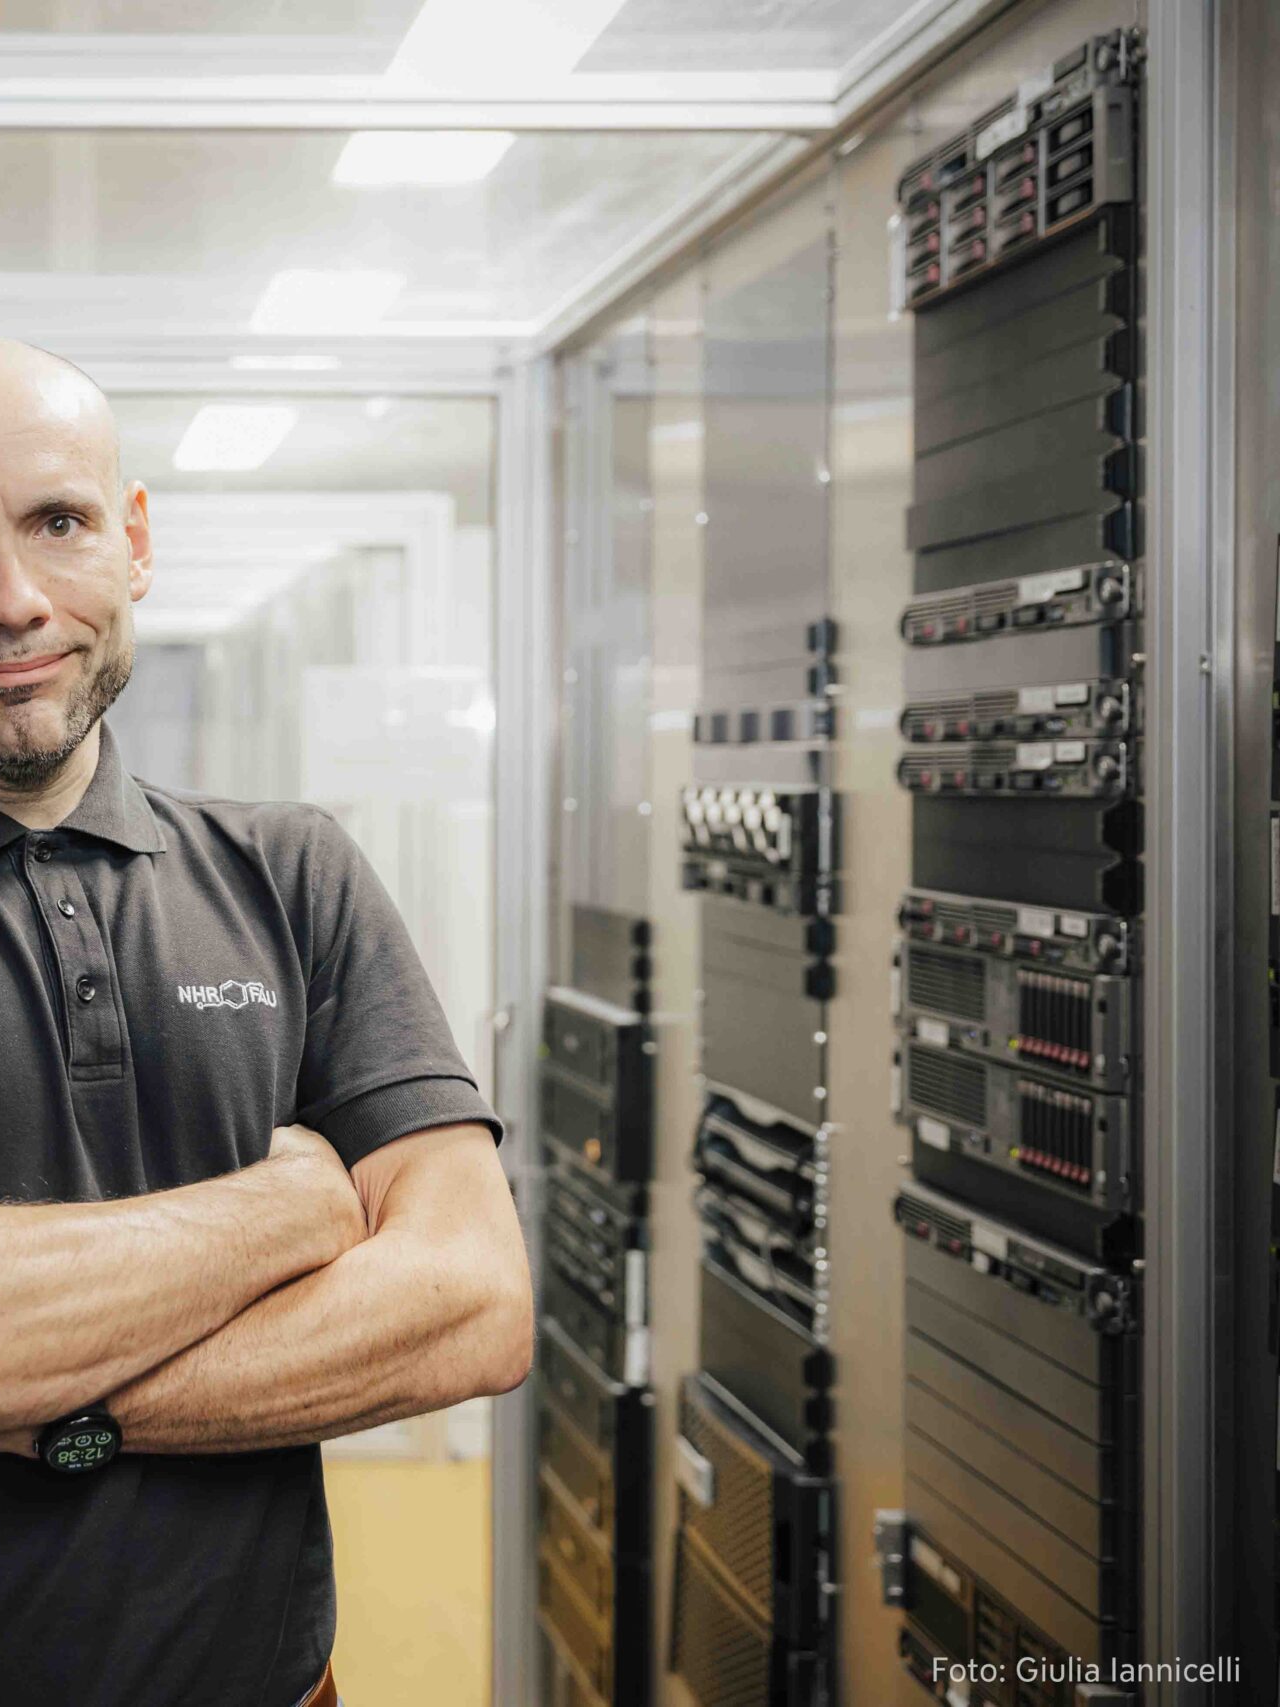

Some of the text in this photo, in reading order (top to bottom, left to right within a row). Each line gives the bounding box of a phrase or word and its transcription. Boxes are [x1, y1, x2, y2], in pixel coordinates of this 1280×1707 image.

[177, 985, 277, 1008] NHR FAU
[58, 1447, 104, 1463] 12:38
